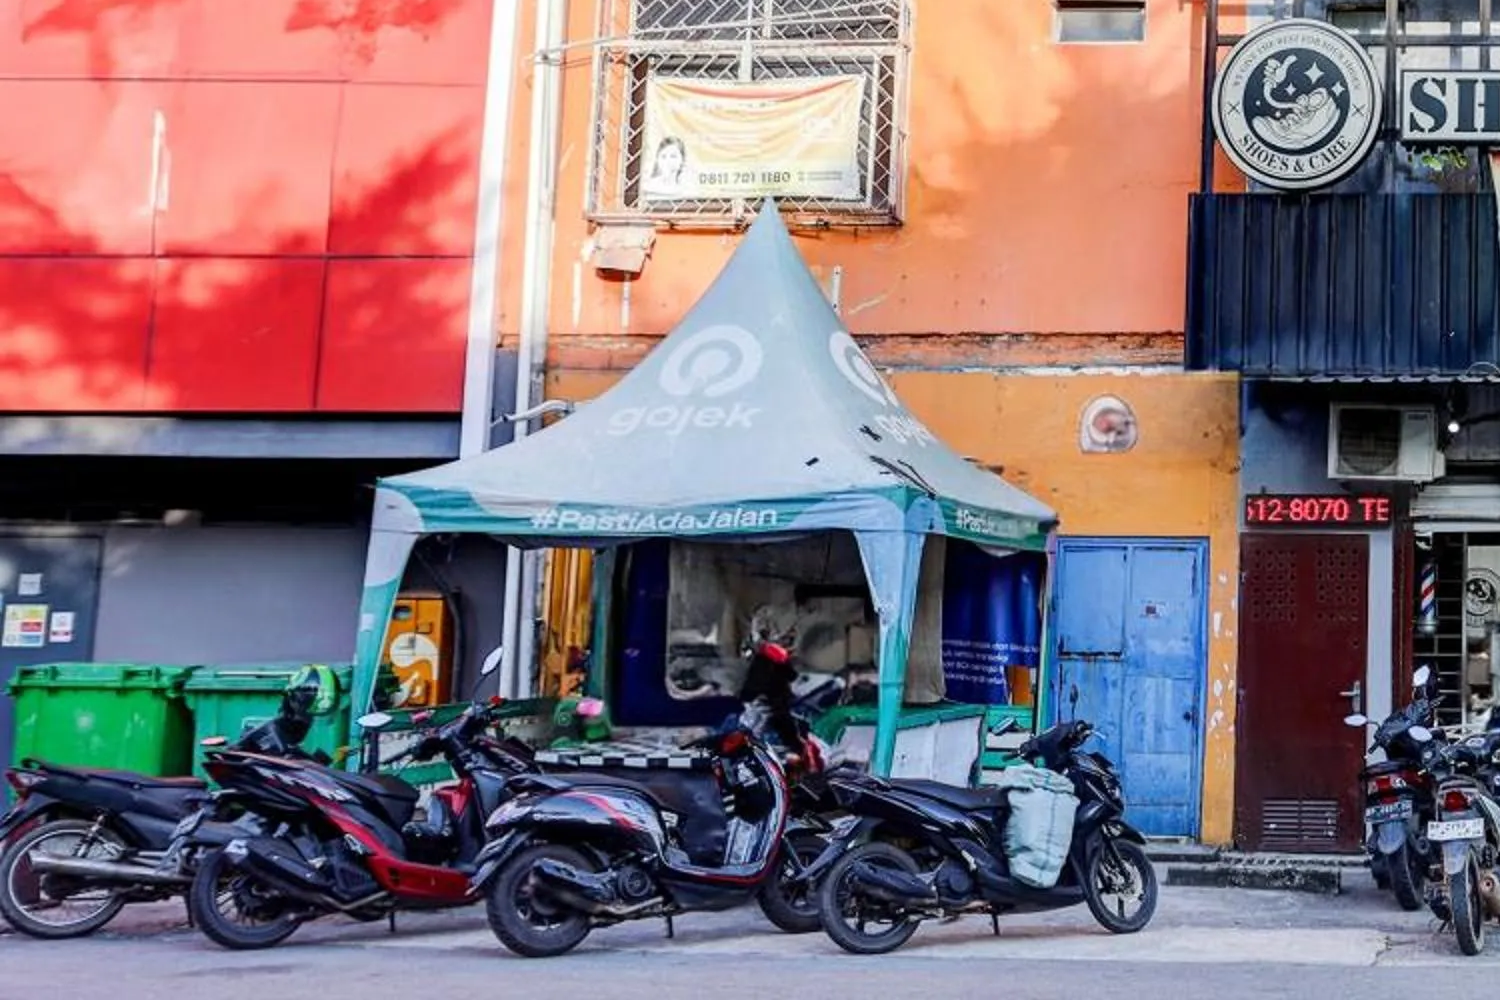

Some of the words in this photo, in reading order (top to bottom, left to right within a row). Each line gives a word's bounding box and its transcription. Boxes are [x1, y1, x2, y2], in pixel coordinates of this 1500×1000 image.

[1240, 135, 1290, 172] SHOES
[1293, 157, 1305, 173] &
[1308, 135, 1351, 170] CARE
[606, 401, 762, 437] gojek
[530, 505, 778, 531] #PastiAdaJalan
[1358, 498, 1389, 521] TE
